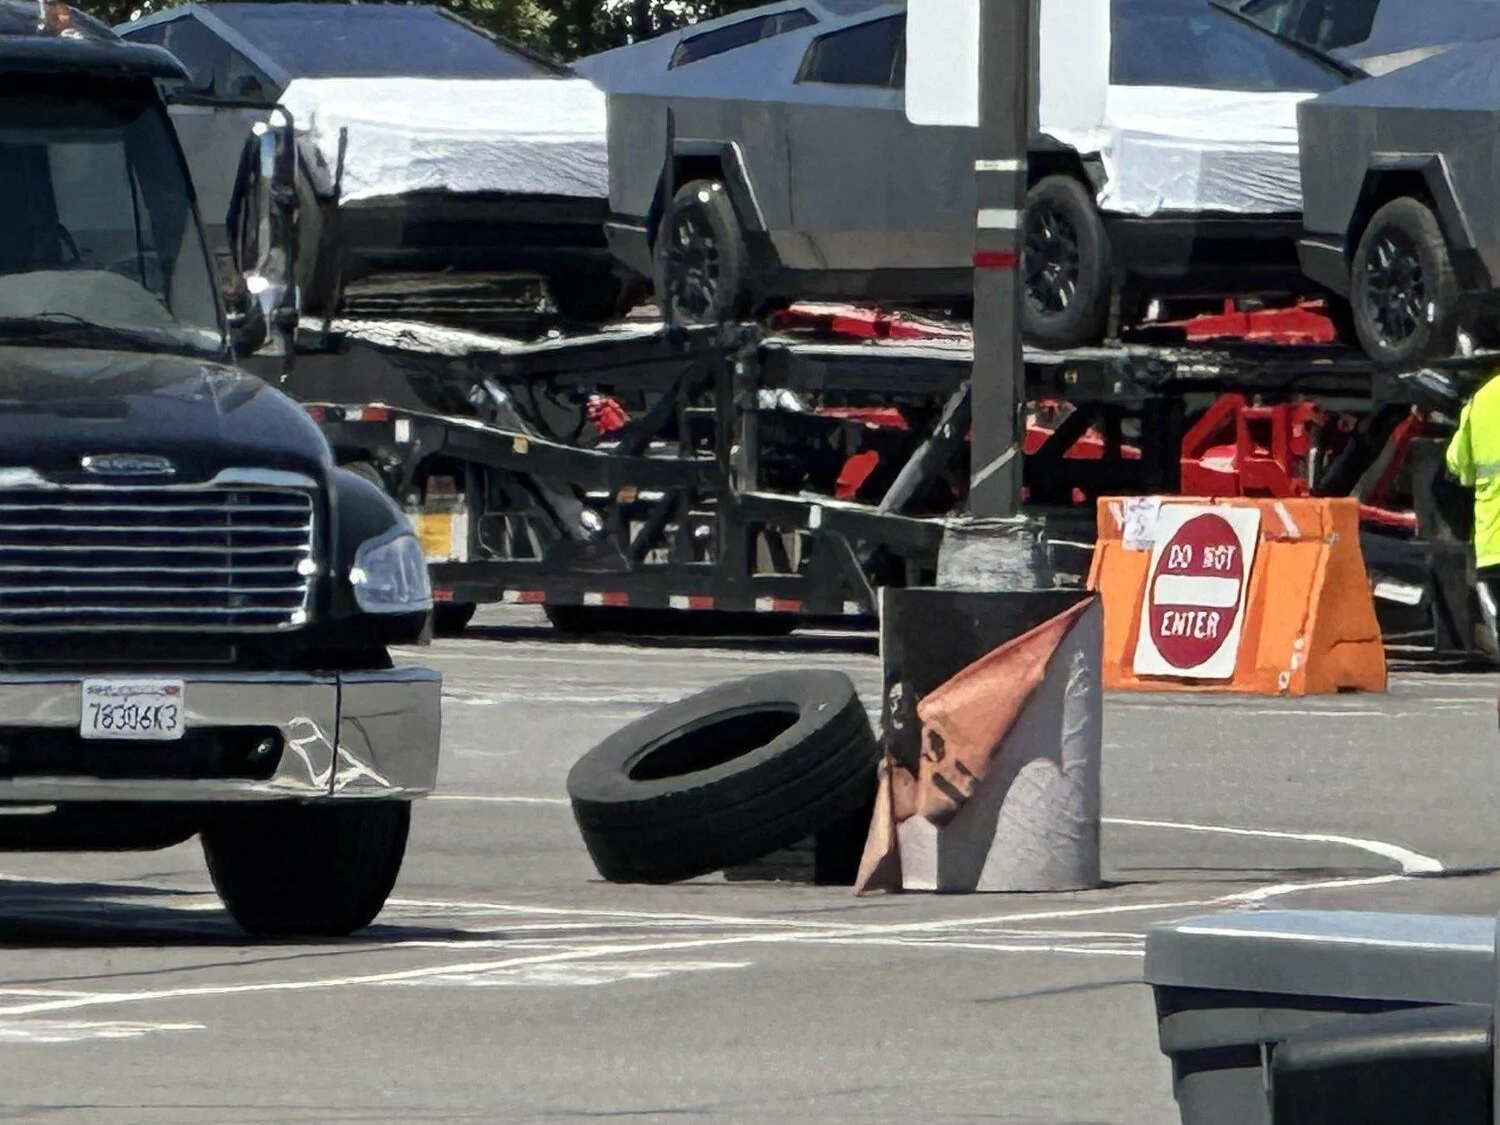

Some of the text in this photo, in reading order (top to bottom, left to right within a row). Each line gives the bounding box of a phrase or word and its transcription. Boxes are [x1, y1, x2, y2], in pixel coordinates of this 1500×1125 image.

[1168, 544, 1236, 570] DO NOT
[1161, 610, 1220, 638] ENTER
